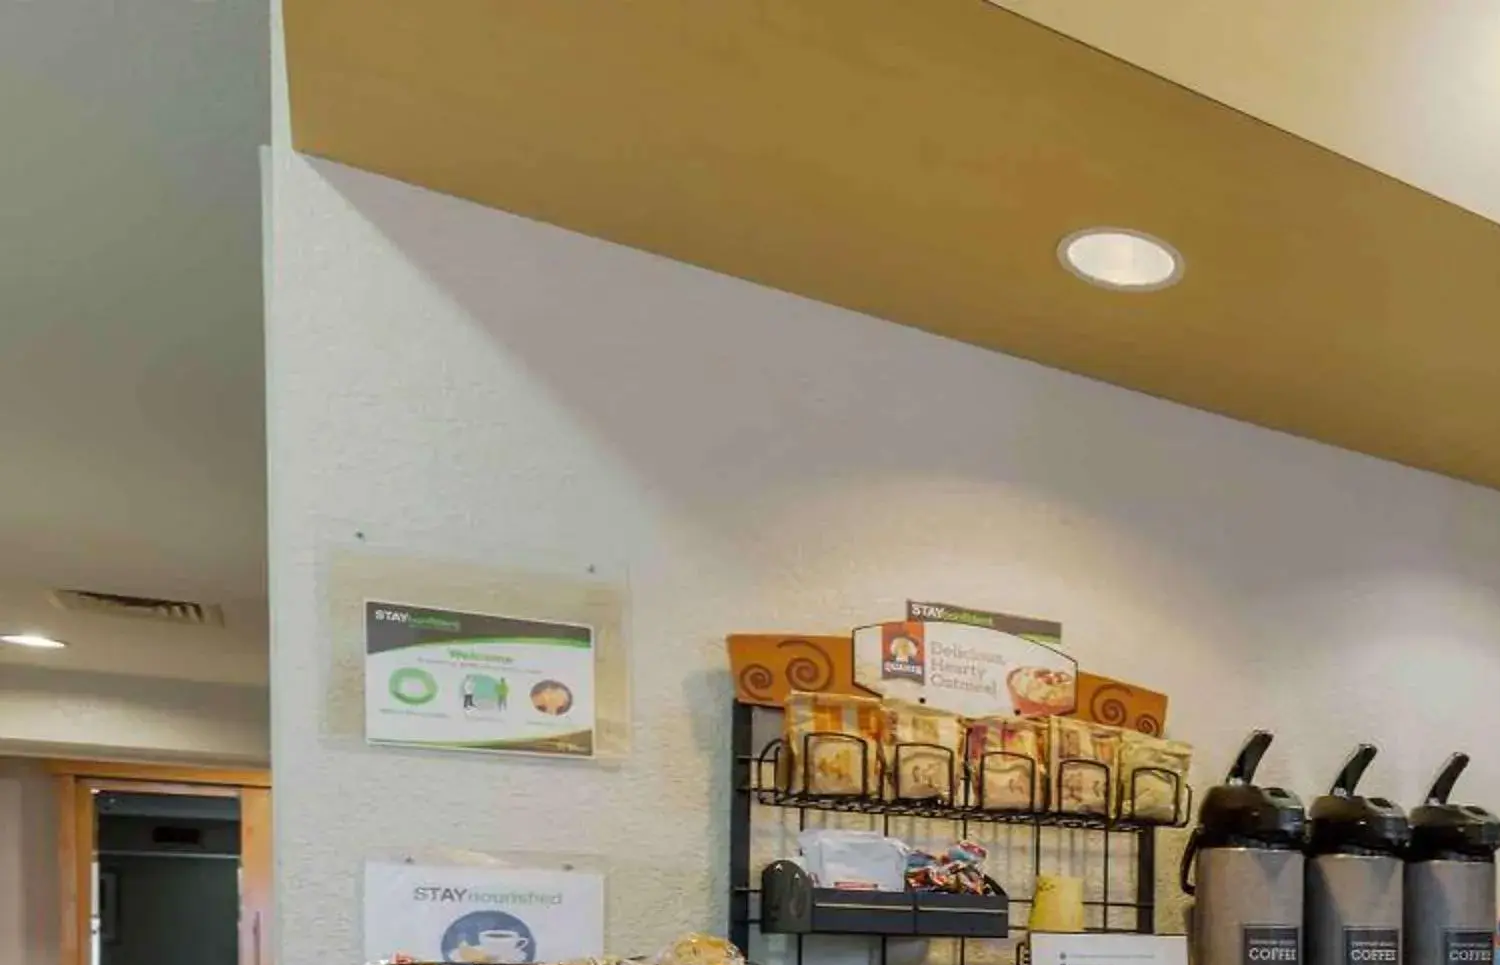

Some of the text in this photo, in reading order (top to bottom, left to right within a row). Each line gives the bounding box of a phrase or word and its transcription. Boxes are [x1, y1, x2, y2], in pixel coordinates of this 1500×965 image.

[931, 657, 986, 680] Hearty
[930, 673, 997, 698] Oatmeal
[1248, 947, 1297, 961] COFFEE
[1351, 948, 1397, 961] COFFEE
